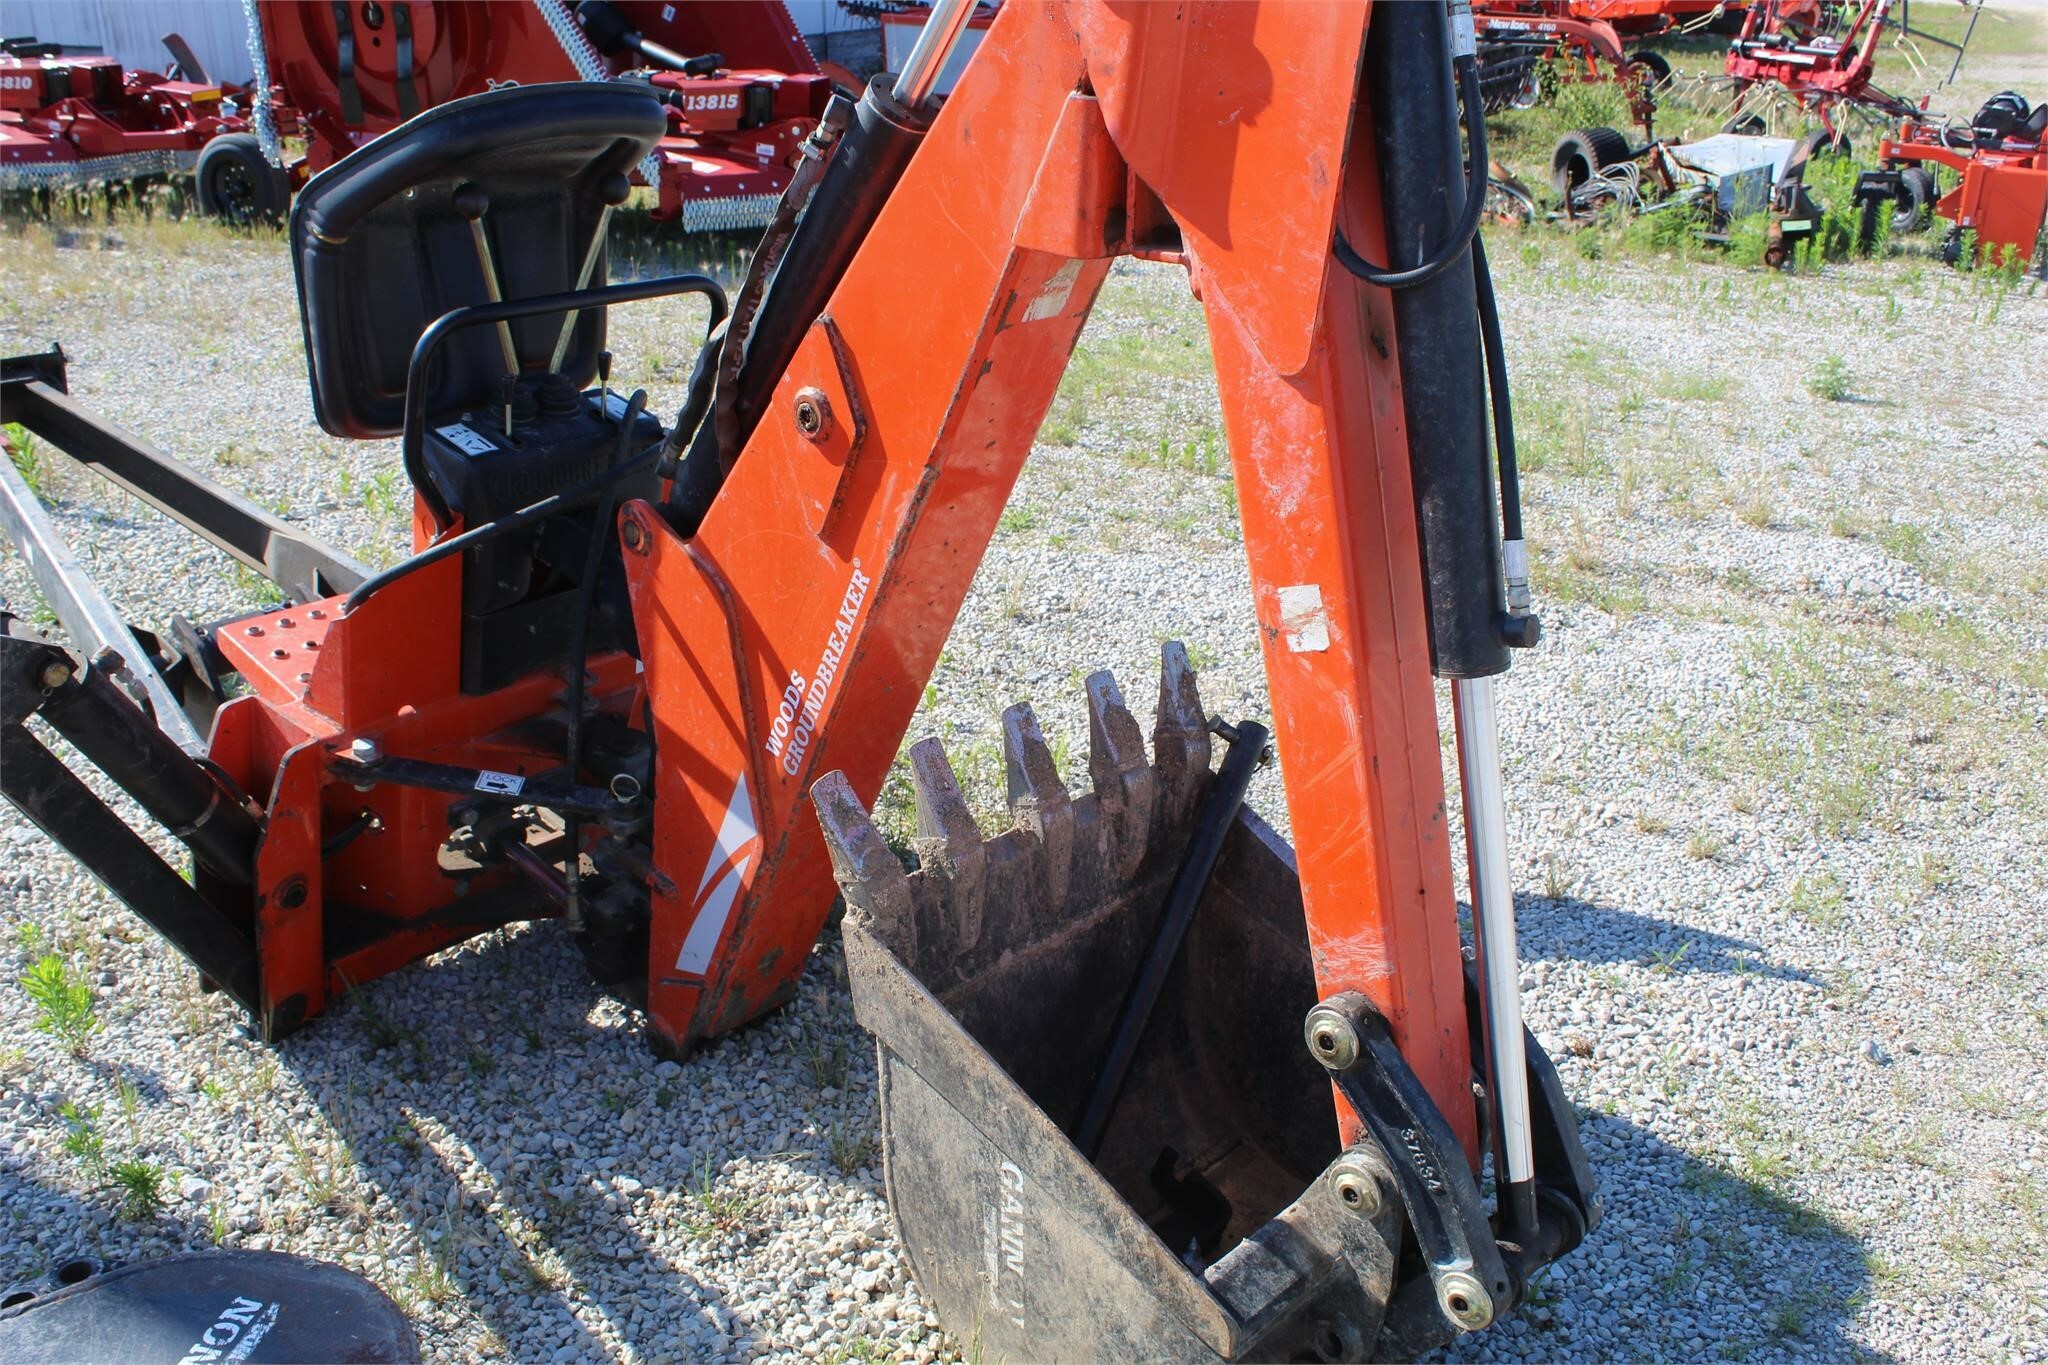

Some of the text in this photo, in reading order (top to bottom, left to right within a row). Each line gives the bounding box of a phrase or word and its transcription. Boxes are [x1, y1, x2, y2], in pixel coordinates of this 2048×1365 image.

[1538, 23, 1557, 32] 4160
[0, 76, 32, 90] 810
[687, 94, 738, 111] 13815
[766, 669, 807, 757] WOODS
[486, 773, 518, 785] LOCK
